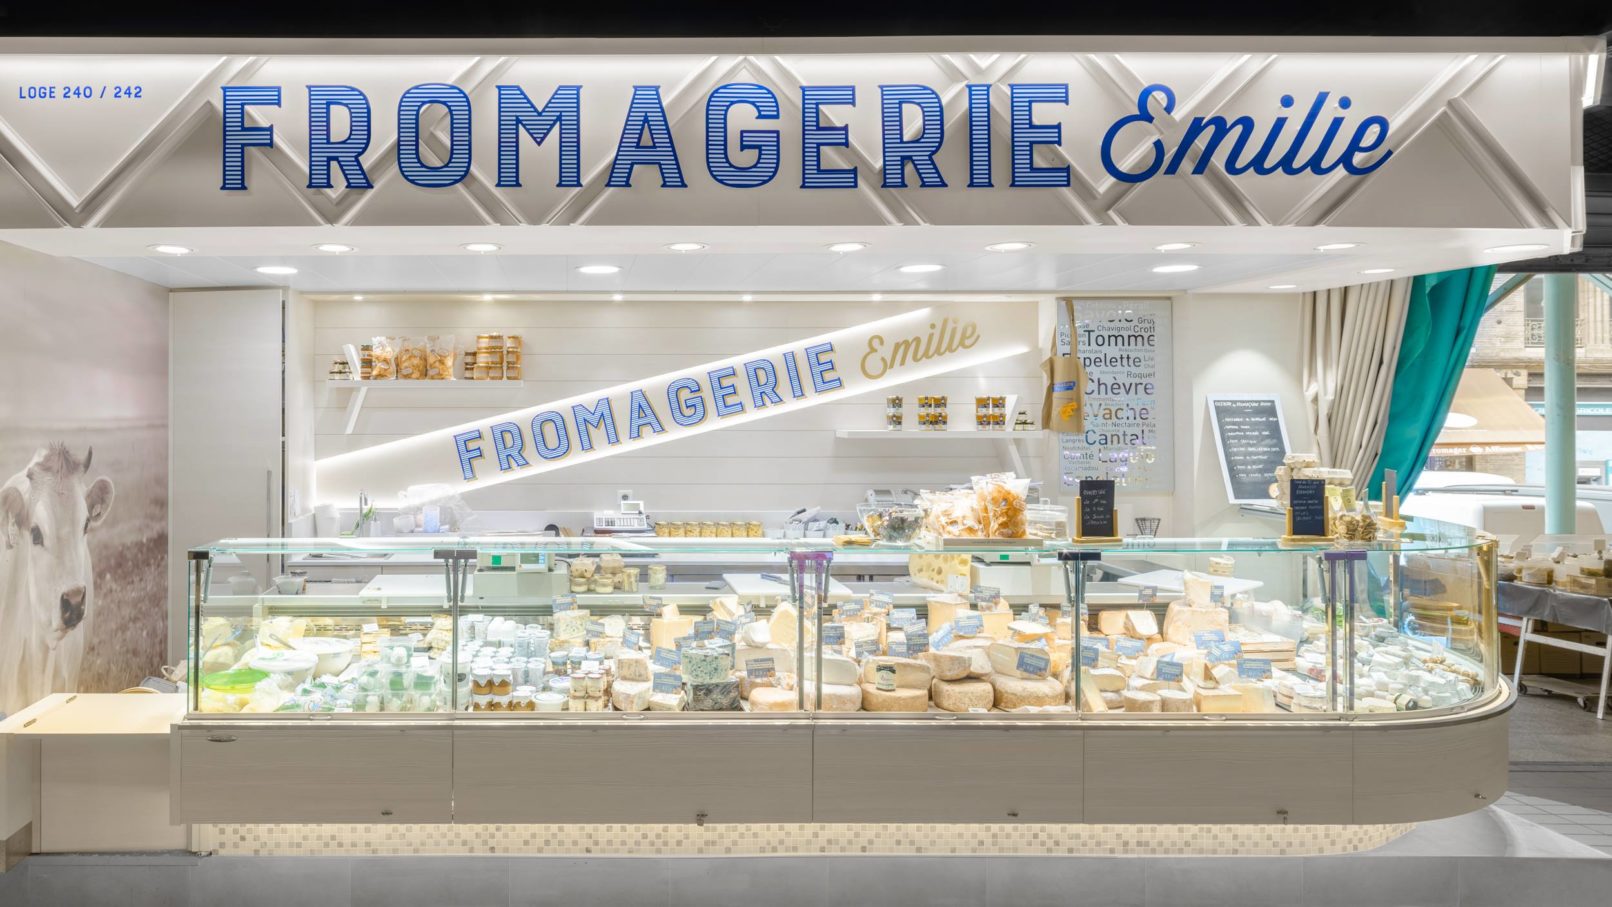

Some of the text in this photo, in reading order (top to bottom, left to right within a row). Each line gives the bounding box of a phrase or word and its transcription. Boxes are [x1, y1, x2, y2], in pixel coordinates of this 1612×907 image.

[19, 86, 143, 99] LOGE 240 / 242
[220, 83, 1393, 190] FROMAGERIE Emilie
[1097, 325, 1132, 333] Chavignol
[1083, 329, 1155, 347] Tomme
[1085, 377, 1155, 395] Chèvre
[454, 318, 980, 481] FROMAGERIE Emilie
[1090, 404, 1149, 421] Vache
[1085, 429, 1147, 446] Cantal
